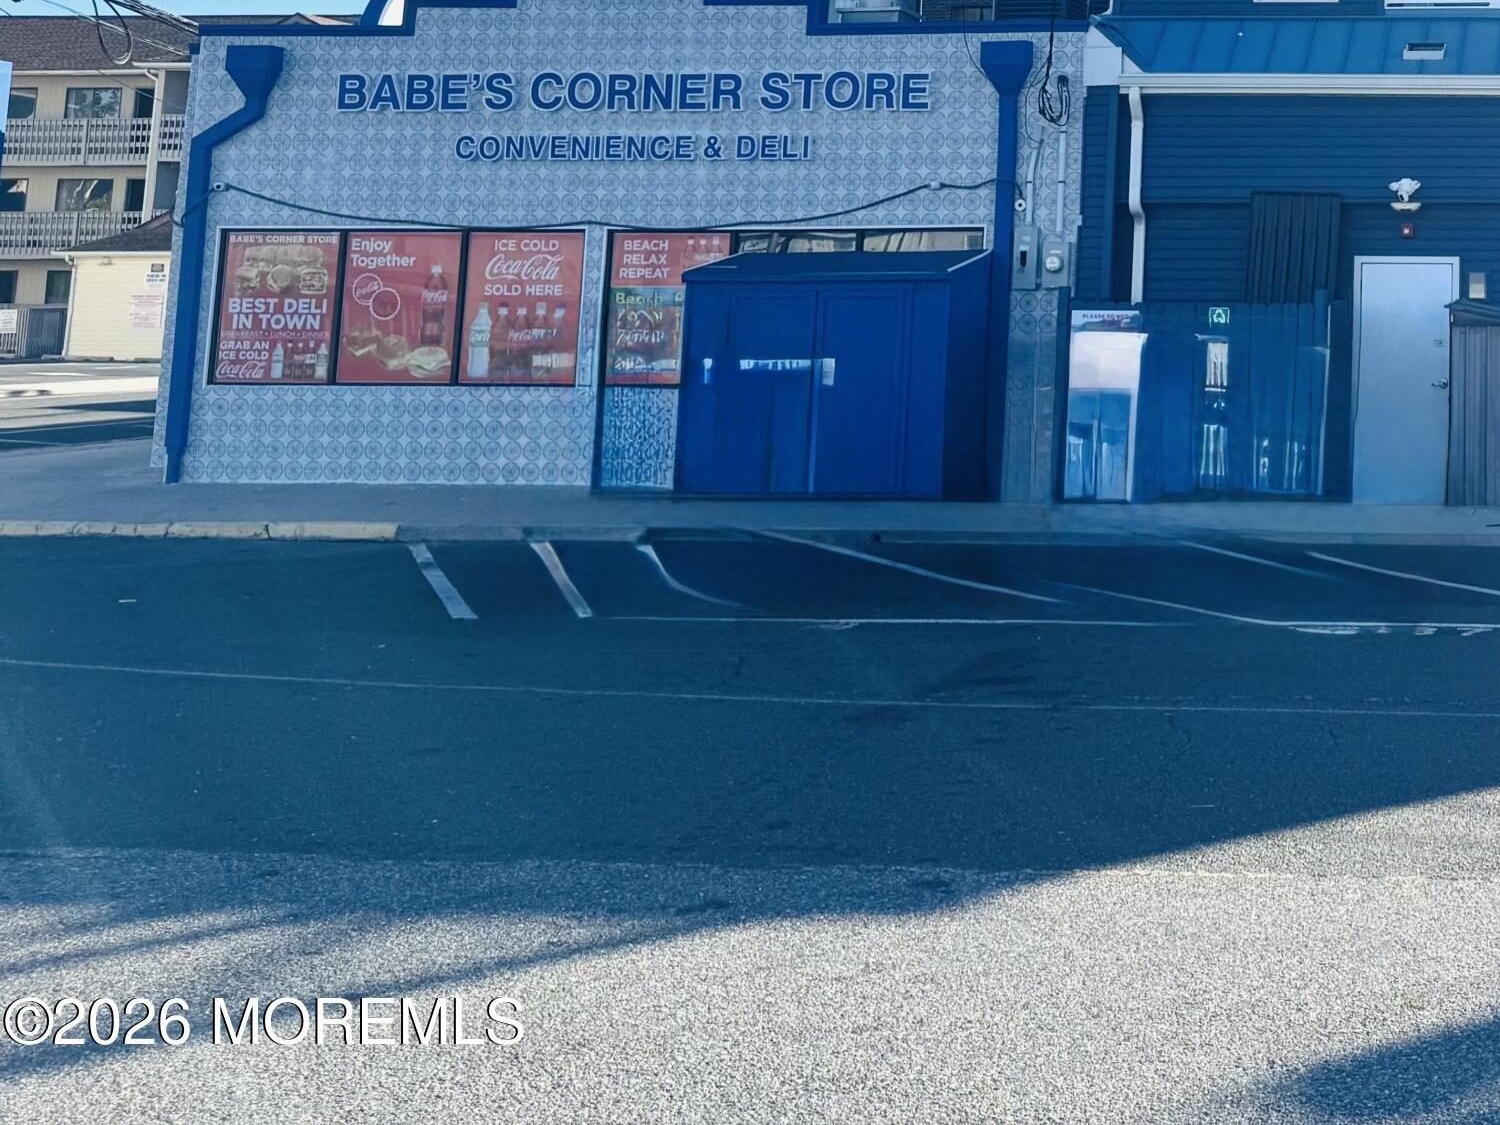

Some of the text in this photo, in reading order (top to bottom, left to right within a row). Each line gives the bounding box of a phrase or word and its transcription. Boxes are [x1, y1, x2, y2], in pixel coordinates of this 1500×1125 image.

[336, 70, 931, 111] BABE'S CORNER STORE
[455, 135, 811, 160] CONVENIENCE & DELI
[229, 235, 338, 244] BABE'S CORNER STORE
[351, 237, 392, 254] Enjoy
[494, 239, 560, 251] ICE COLD
[623, 239, 669, 251] BEACH
[351, 254, 416, 269] Together
[623, 253, 668, 265] RELAX
[619, 267, 670, 279] REPEAT
[484, 284, 563, 296] SOLD HERE
[228, 297, 328, 314] BEST DELI
[231, 313, 321, 330] IN TOWN
[270, 330, 296, 338] LUNCH
[219, 340, 270, 350] GRAB AN
[218, 350, 269, 360] ICE COLD
